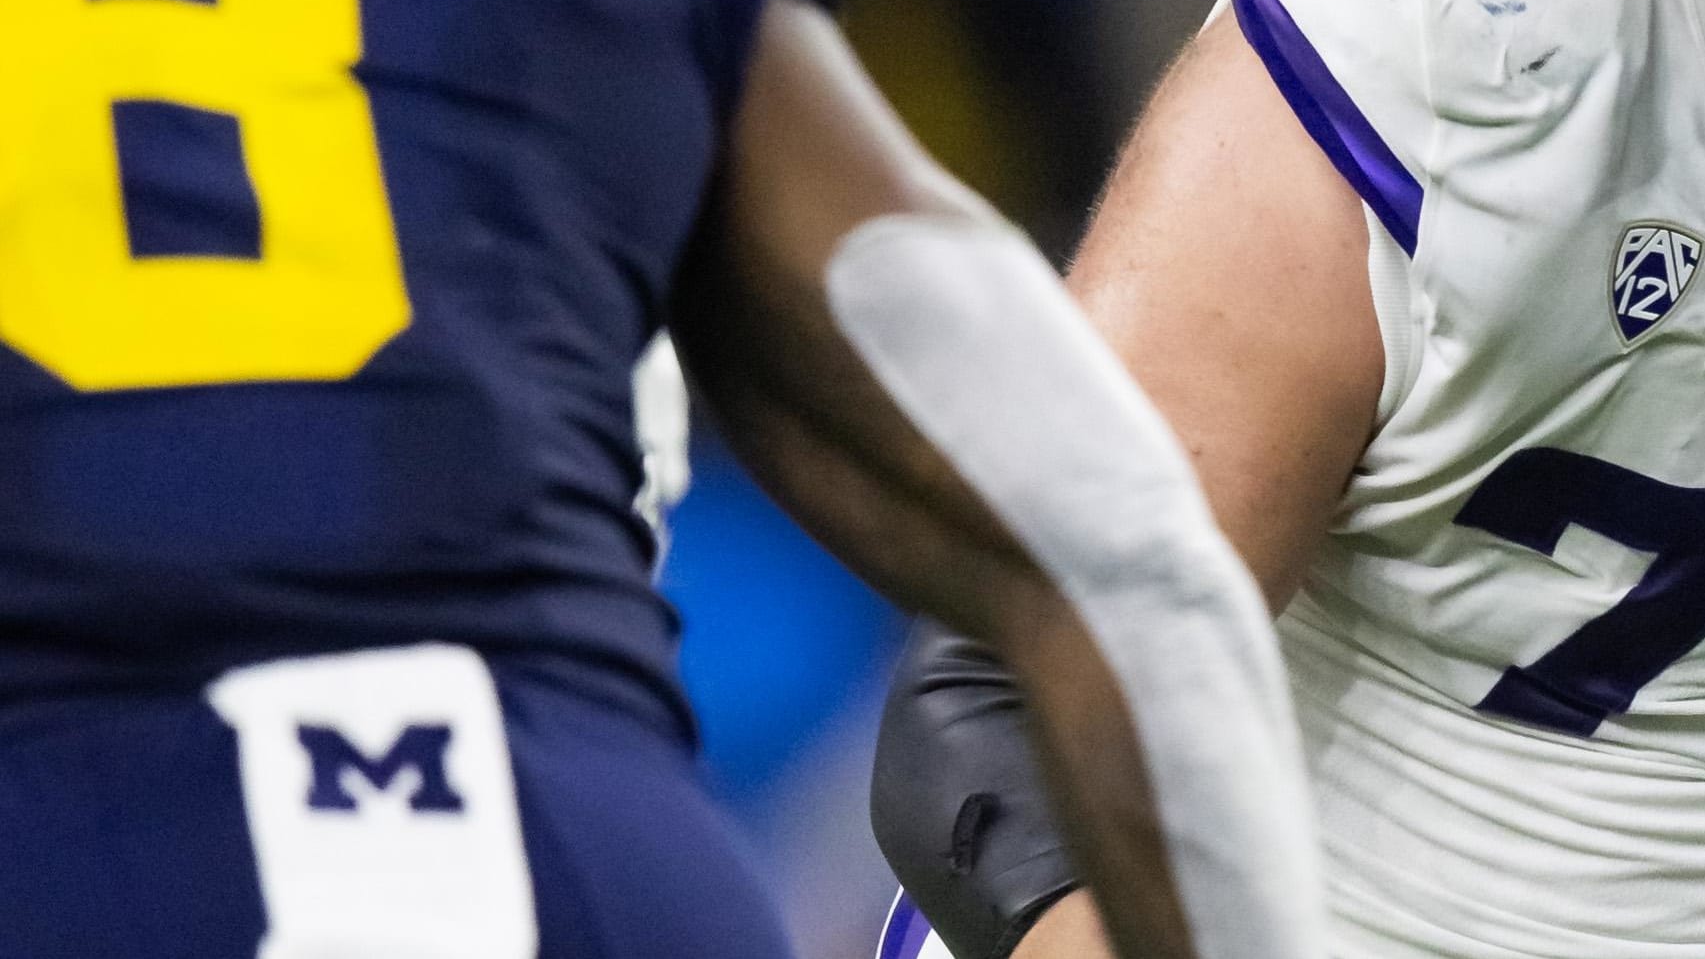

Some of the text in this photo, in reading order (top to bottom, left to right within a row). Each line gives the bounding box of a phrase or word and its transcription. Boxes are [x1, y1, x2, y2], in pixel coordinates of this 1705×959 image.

[1613, 226, 1703, 303] PAC
[1617, 274, 1668, 322] 12
[296, 722, 466, 815] M
